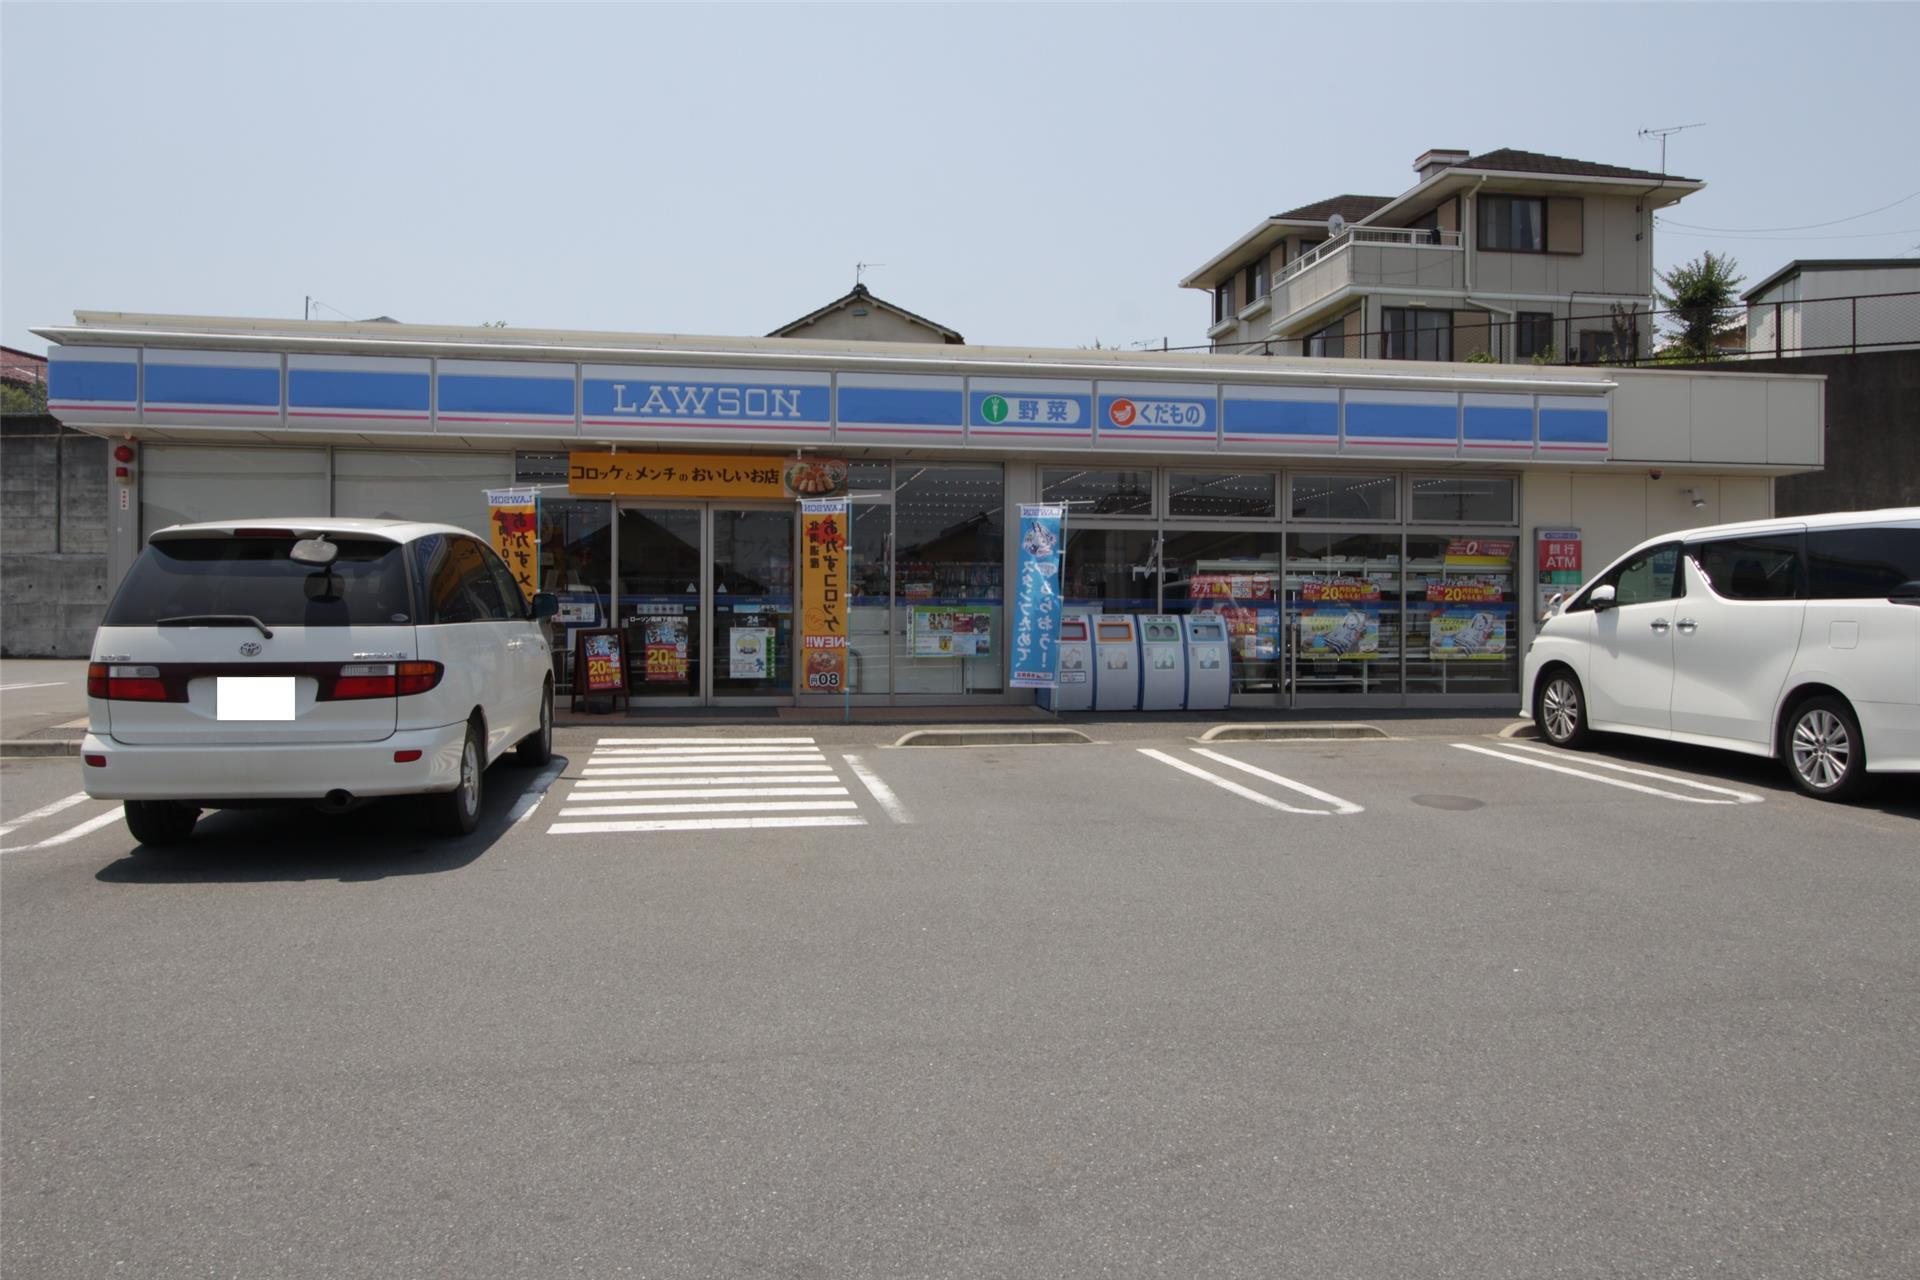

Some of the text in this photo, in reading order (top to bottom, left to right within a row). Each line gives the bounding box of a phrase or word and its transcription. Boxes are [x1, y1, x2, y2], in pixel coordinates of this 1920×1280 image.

[613, 384, 801, 417] LAWSON
[1018, 400, 1067, 422] 野菜
[1140, 403, 1200, 424] くだもの
[1549, 543, 1575, 556] 銀行
[1546, 556, 1576, 568] ATM
